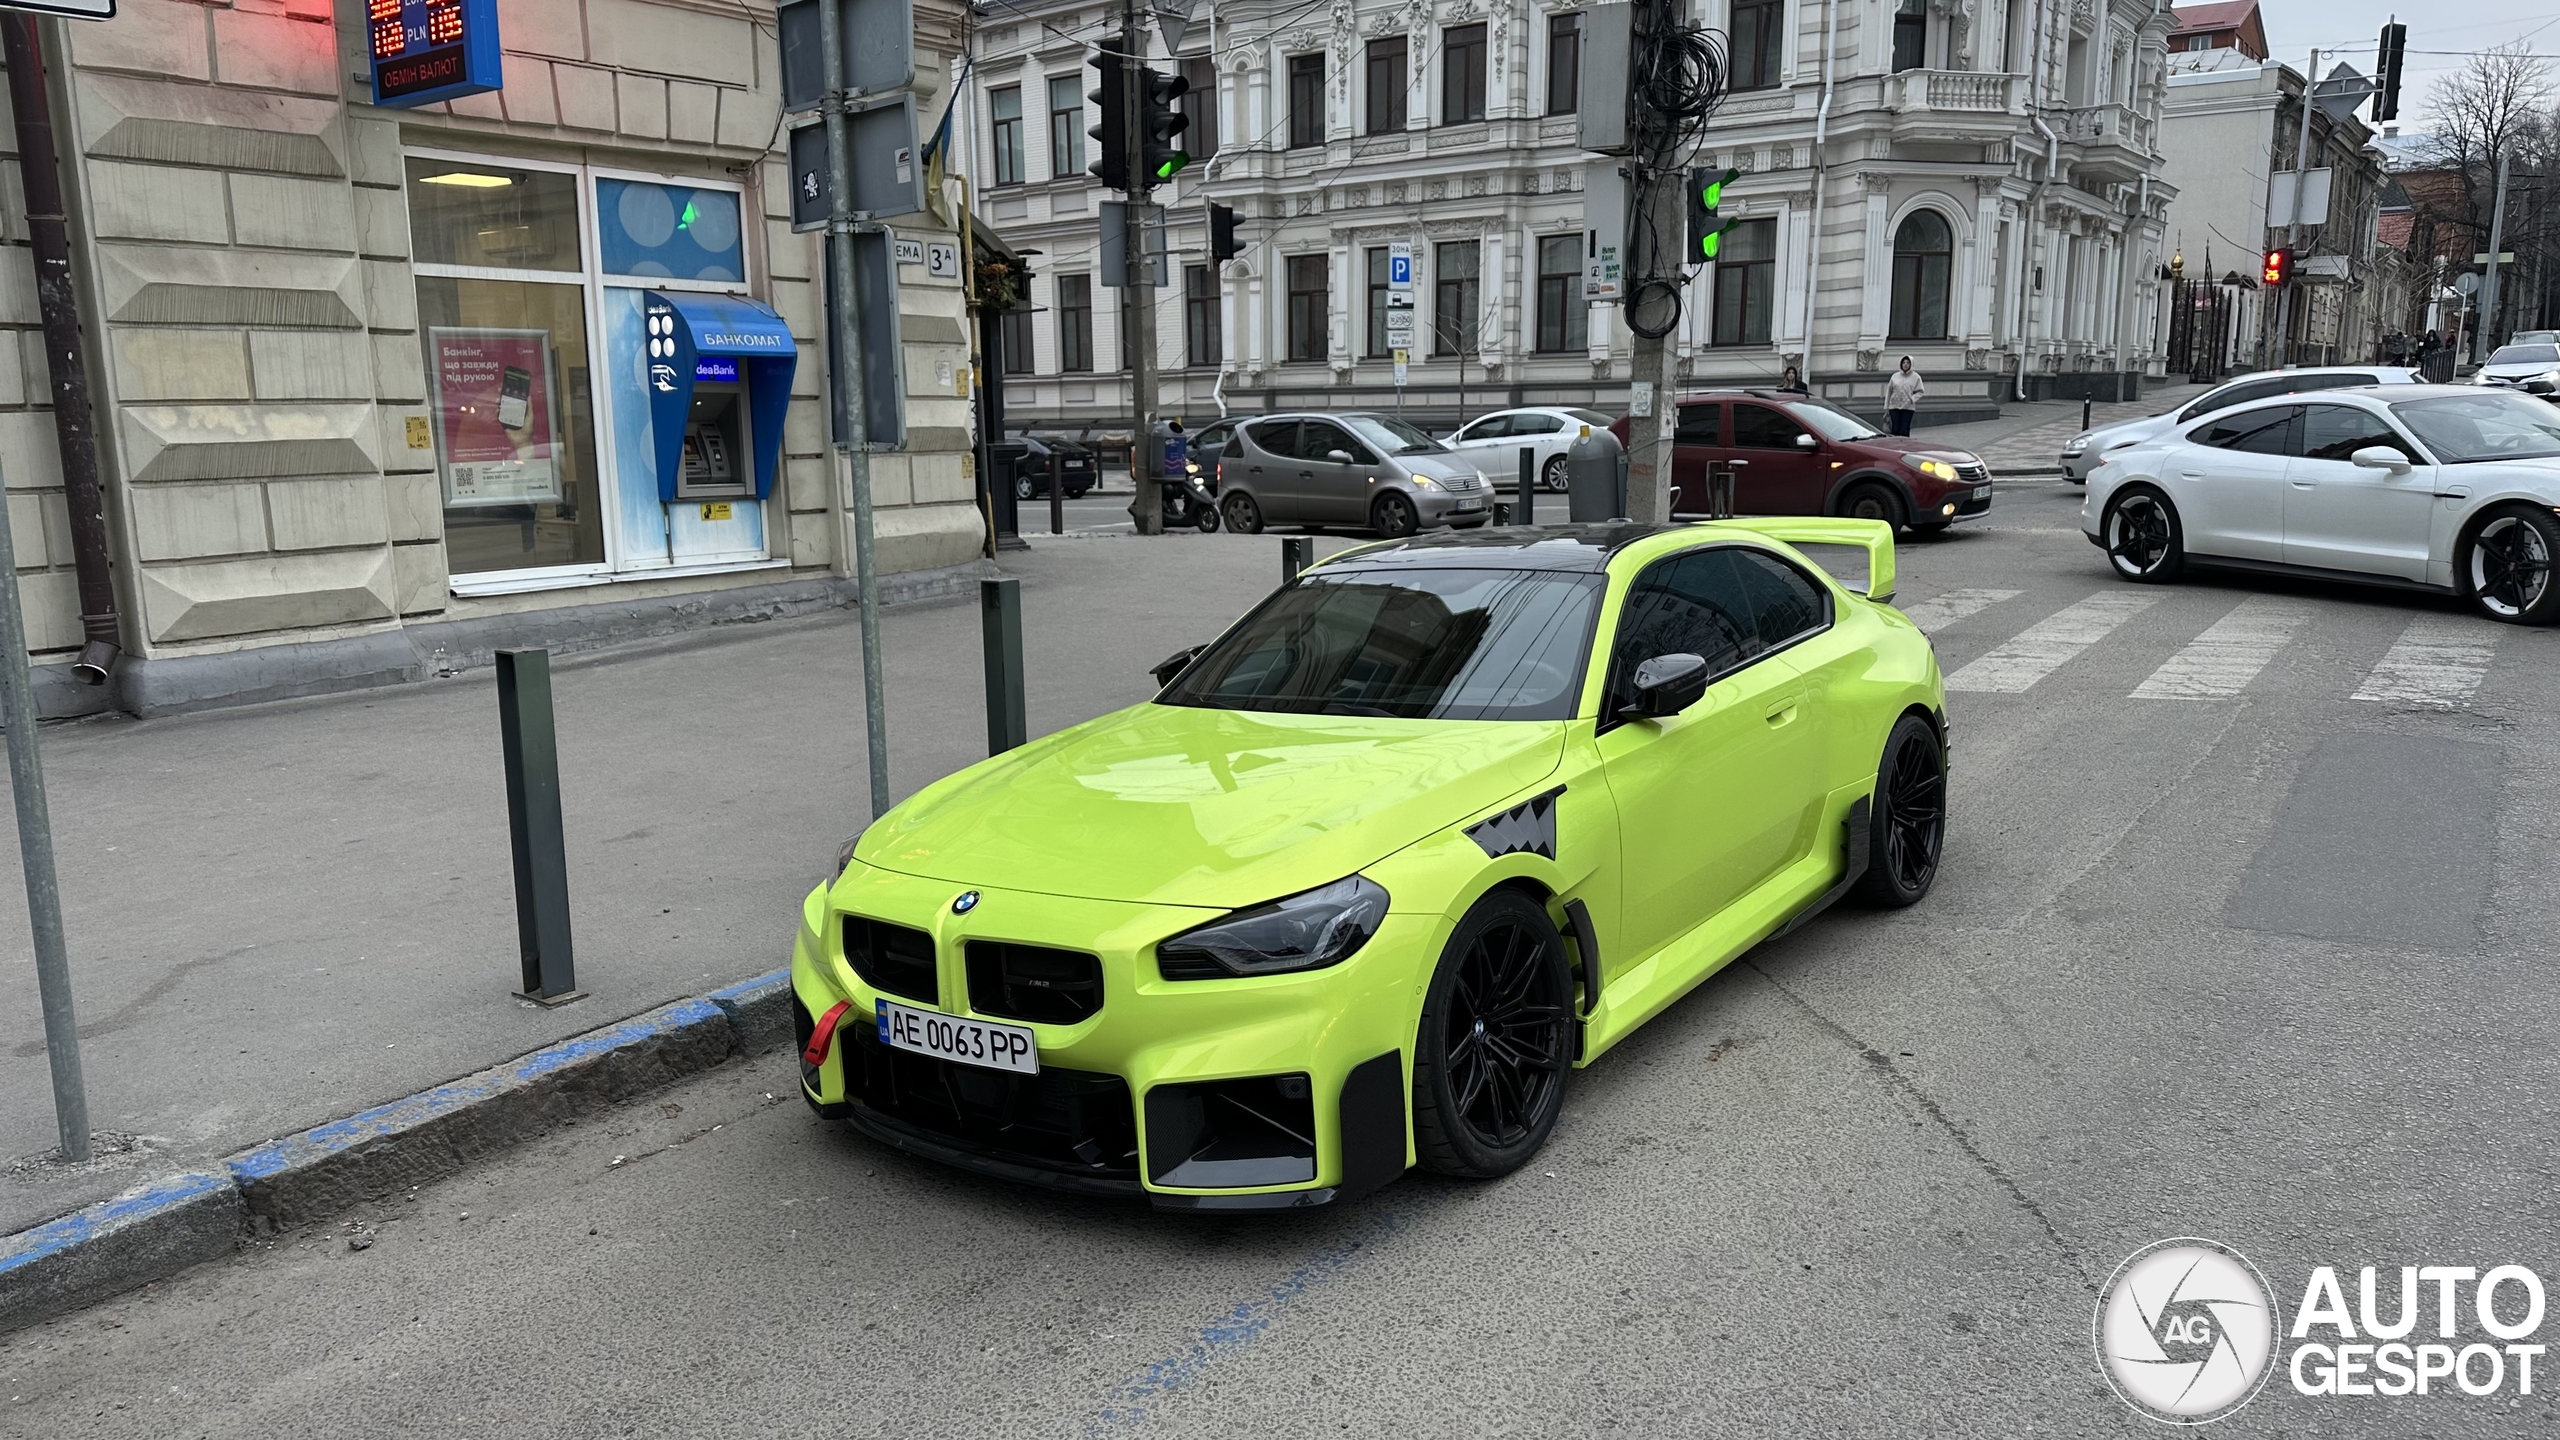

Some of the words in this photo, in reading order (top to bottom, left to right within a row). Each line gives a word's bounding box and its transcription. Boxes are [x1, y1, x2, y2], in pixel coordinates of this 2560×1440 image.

[407, 25, 427, 42] PLN
[384, 65, 417, 88] ОБМІН
[420, 57, 457, 80] ВАЛЮТ
[896, 245, 919, 258] ЕМА
[704, 333, 782, 347] БАНКОМАТ
[443, 346, 483, 357] Банкінг,
[444, 361, 460, 370] що
[462, 361, 499, 370] завжди
[696, 364, 735, 375] deaBank
[446, 372, 462, 382] під
[463, 373, 495, 384] рукою
[880, 1025, 889, 1037] UA
[893, 1010, 922, 1047] AE
[926, 1018, 984, 1059] 0063
[990, 1029, 1028, 1065] PP
